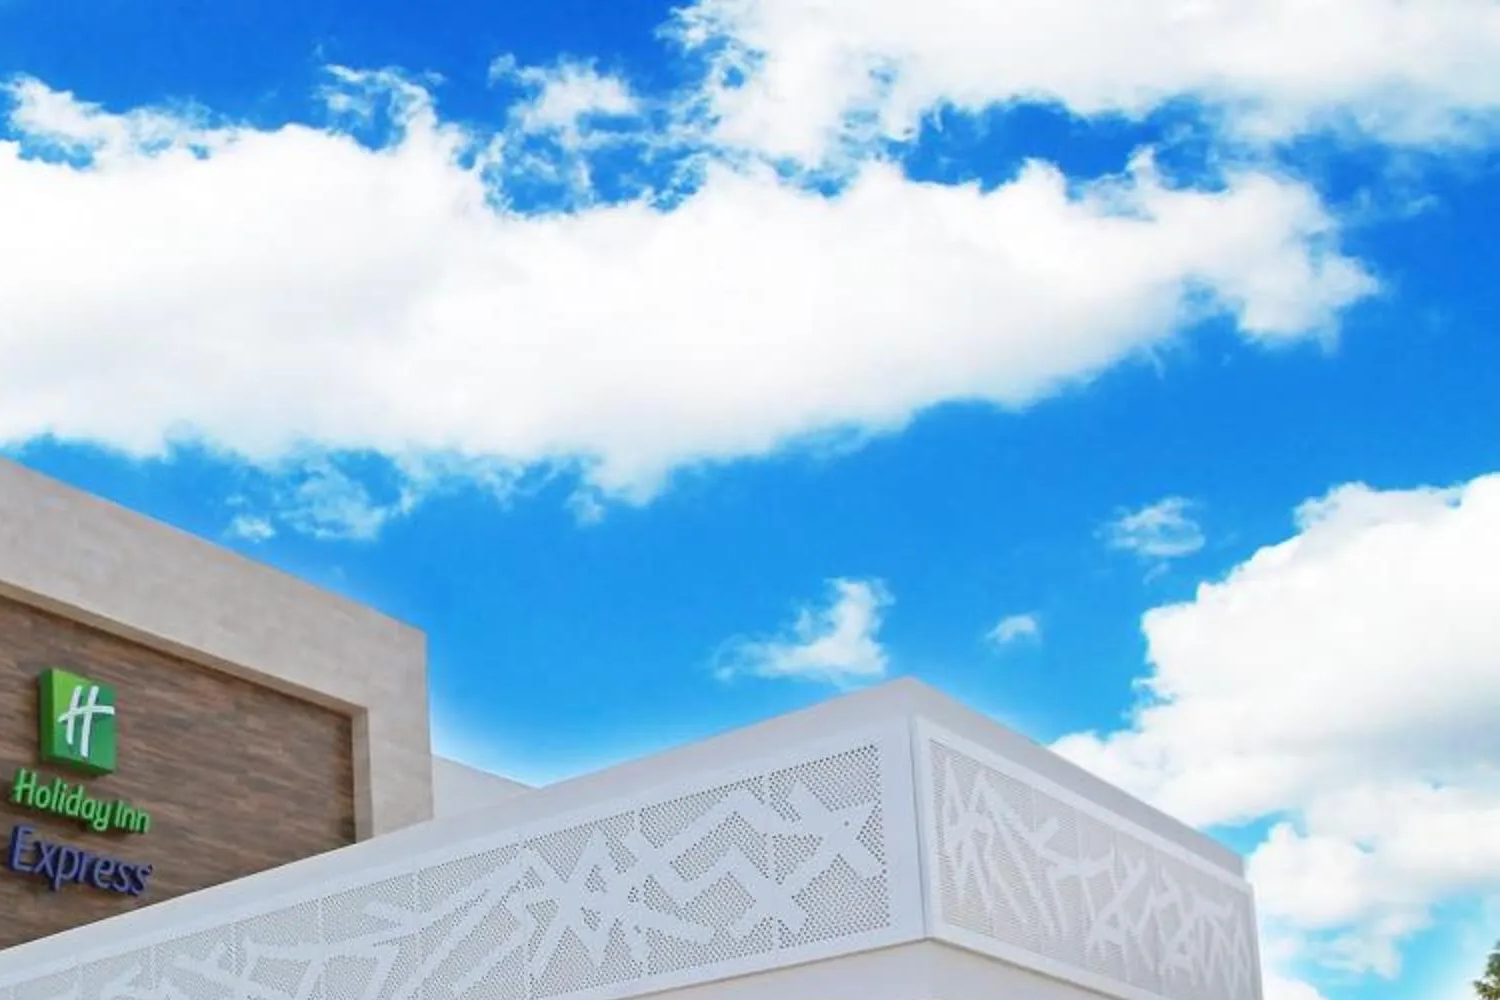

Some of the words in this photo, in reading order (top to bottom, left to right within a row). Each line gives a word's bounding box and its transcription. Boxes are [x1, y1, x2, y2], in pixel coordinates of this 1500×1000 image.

[13, 768, 109, 831] Holiday
[114, 799, 151, 834] Inn
[10, 825, 153, 895] Express
